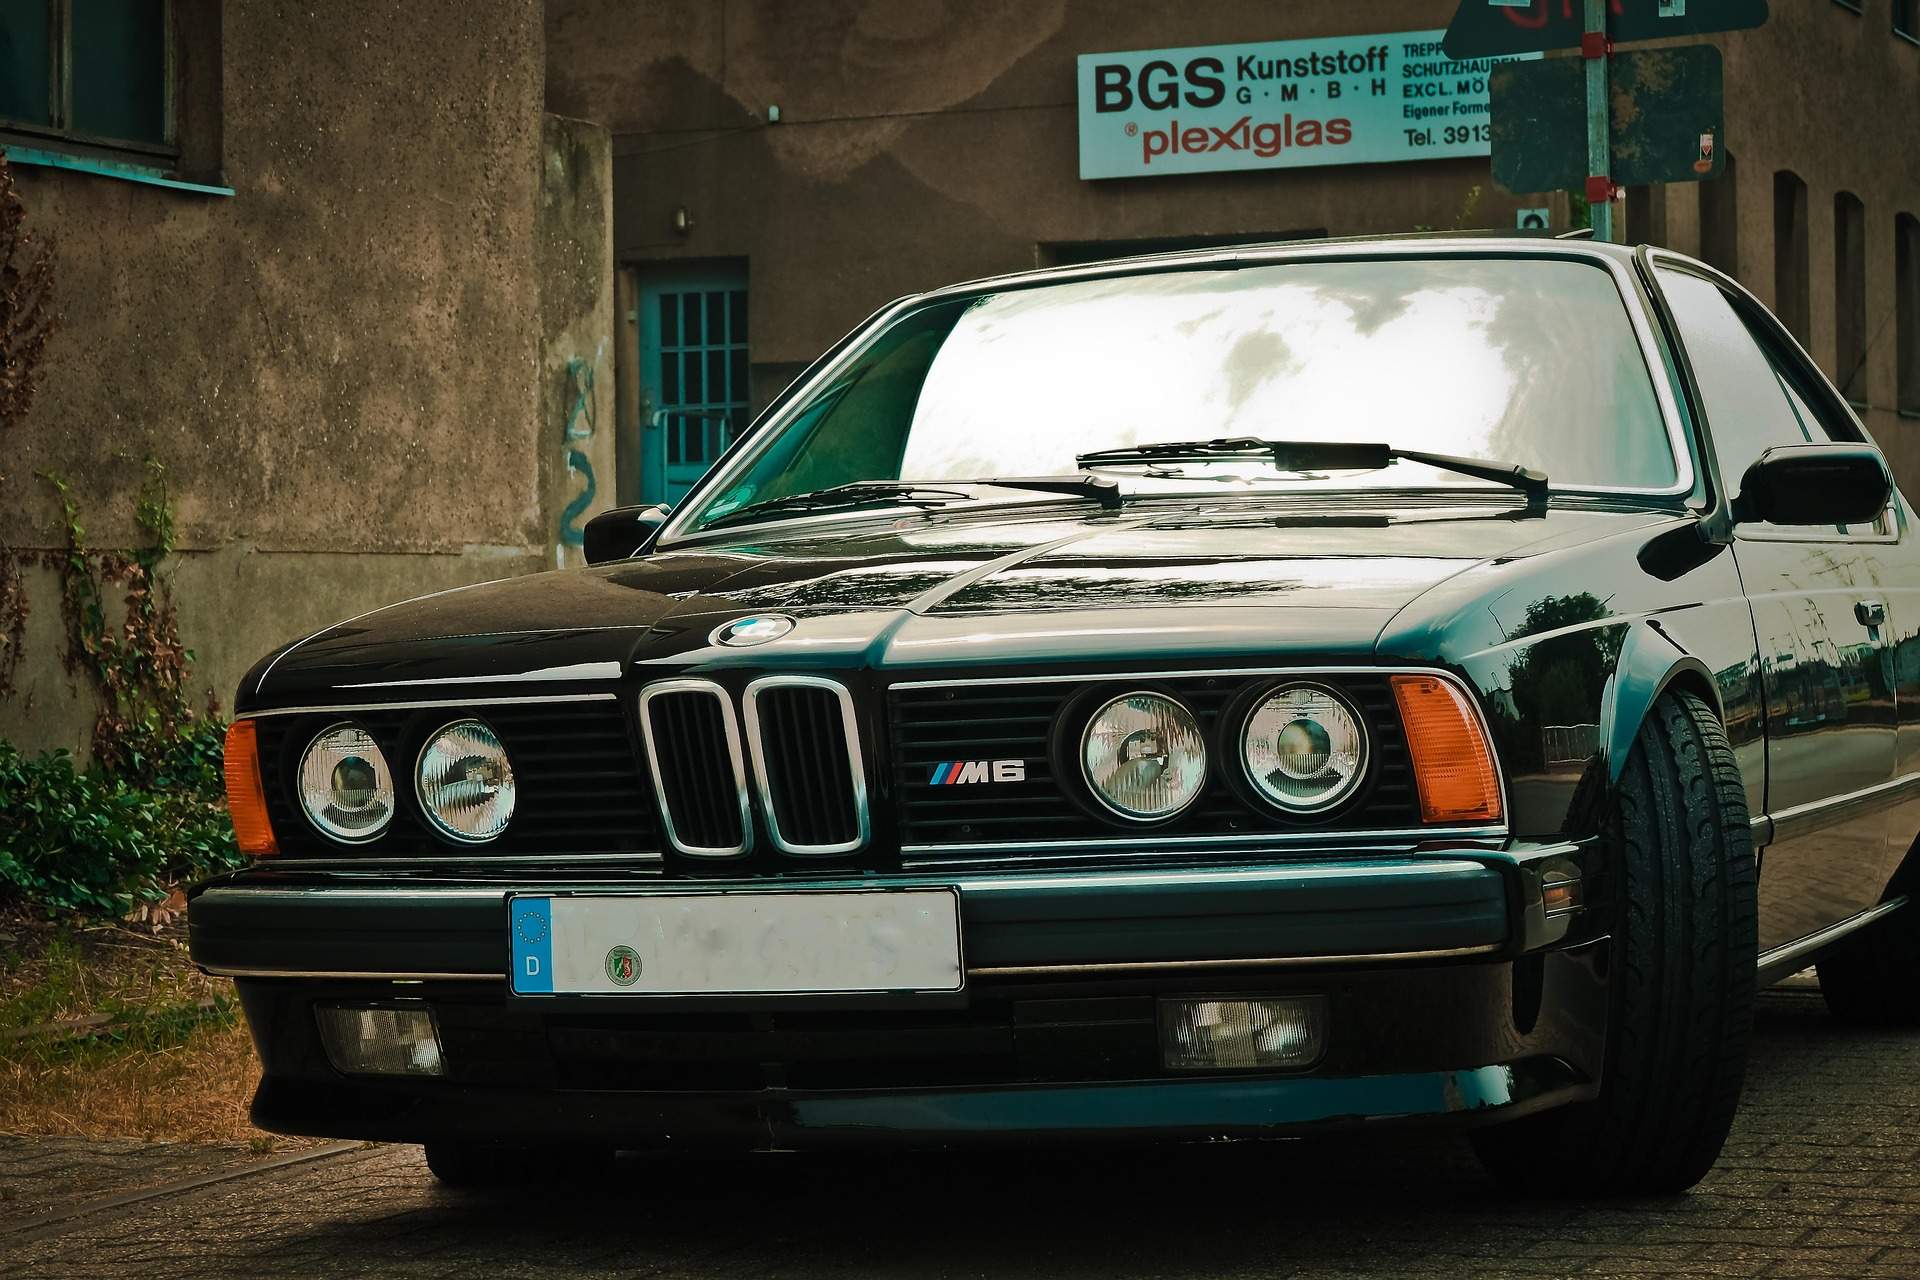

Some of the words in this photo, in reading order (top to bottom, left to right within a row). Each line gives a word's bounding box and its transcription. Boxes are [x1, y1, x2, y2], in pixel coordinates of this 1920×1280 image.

[1237, 46, 1390, 83] Kunststoff
[1095, 57, 1226, 113] BGS
[1403, 82, 1453, 99] EXCL.
[1457, 77, 1490, 95] MÖ
[1403, 104, 1450, 120] Eigener
[1404, 128, 1436, 147] Tel.
[955, 759, 1026, 785] M6
[526, 956, 541, 976] D
